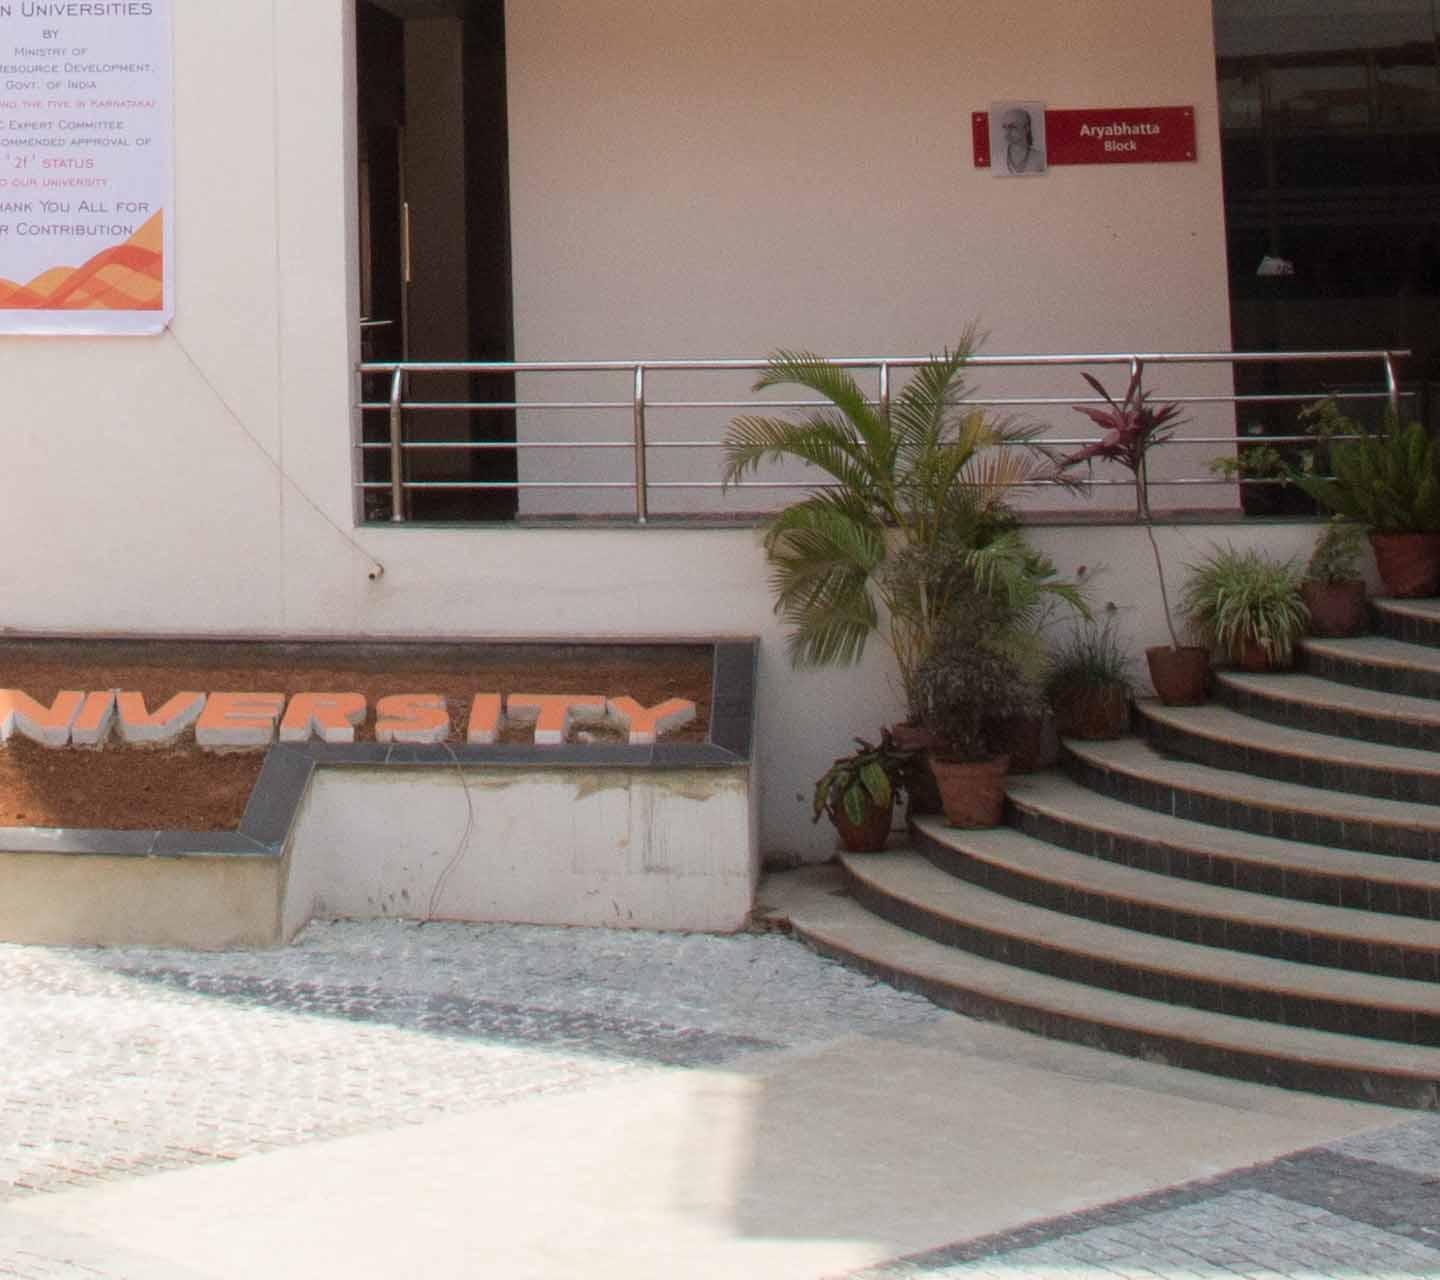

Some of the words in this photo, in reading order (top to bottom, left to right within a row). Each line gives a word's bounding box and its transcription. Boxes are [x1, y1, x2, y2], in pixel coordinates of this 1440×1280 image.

[21, 1, 153, 17] UNIVERSITIES
[42, 29, 59, 39] BY
[1080, 123, 1160, 139] Aryabhatta
[1104, 140, 1137, 152] Block
[41, 158, 94, 169] STATUS
[39, 200, 70, 213] YOU
[78, 200, 108, 213] ALL
[116, 201, 149, 213] FOR
[16, 222, 133, 236] CONTRIBUTION
